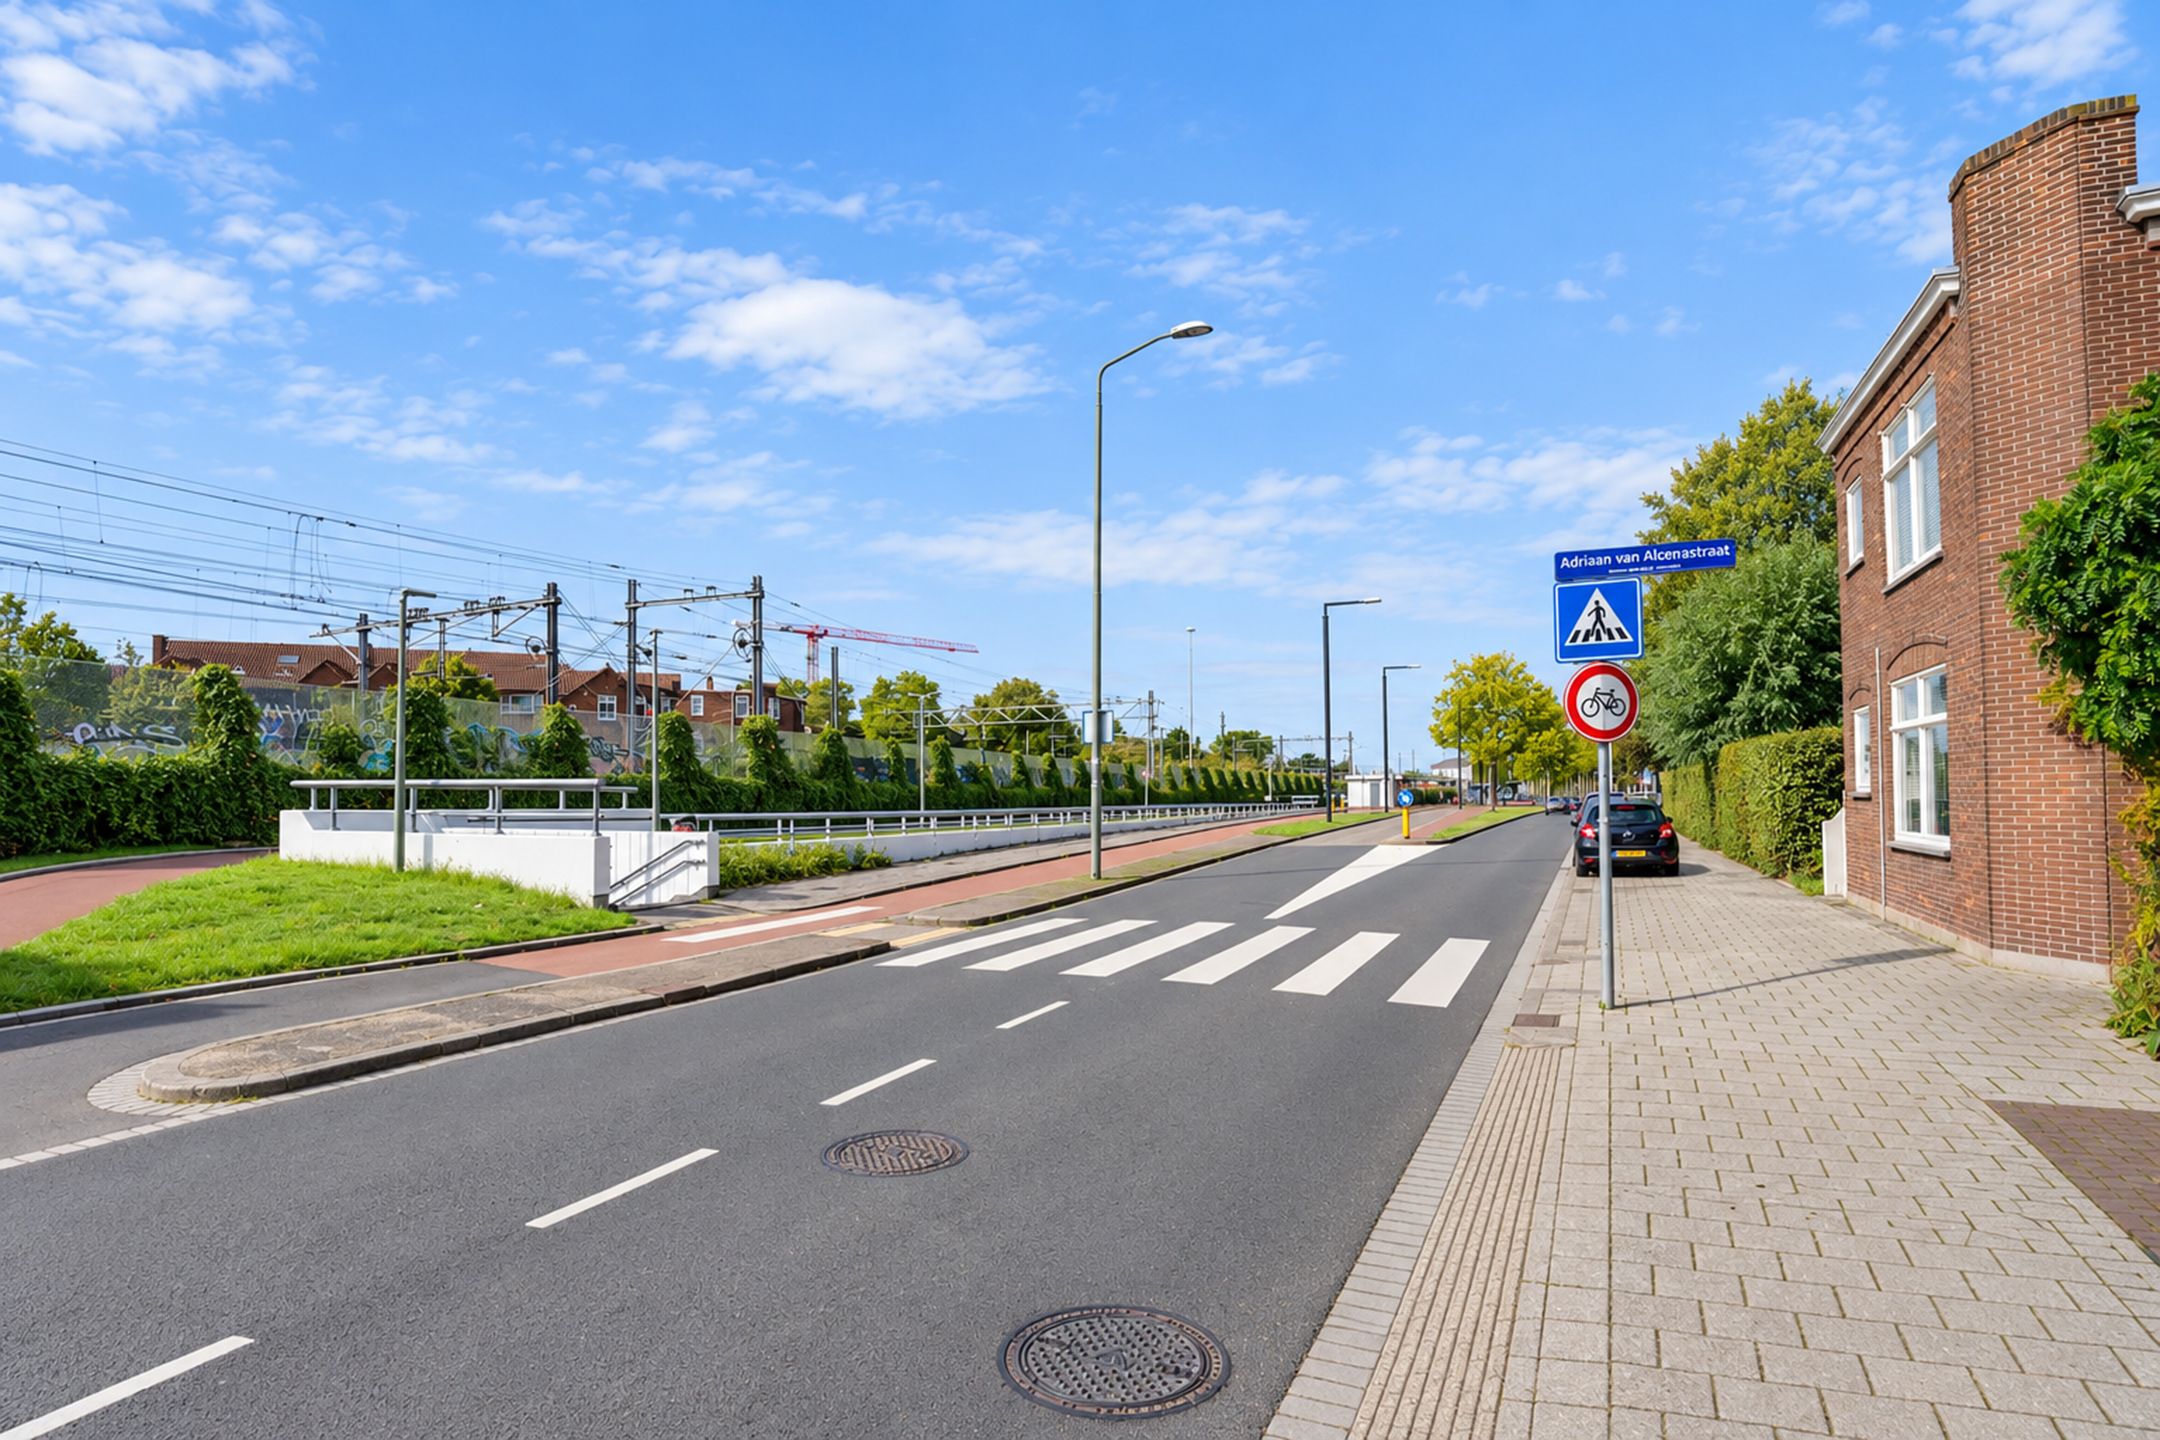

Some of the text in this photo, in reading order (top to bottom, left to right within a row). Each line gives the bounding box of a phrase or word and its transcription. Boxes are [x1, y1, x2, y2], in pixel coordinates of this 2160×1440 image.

[1560, 554, 1611, 569] Adriaan
[1616, 552, 1640, 564] van
[1644, 545, 1730, 562] Alcenastraat
